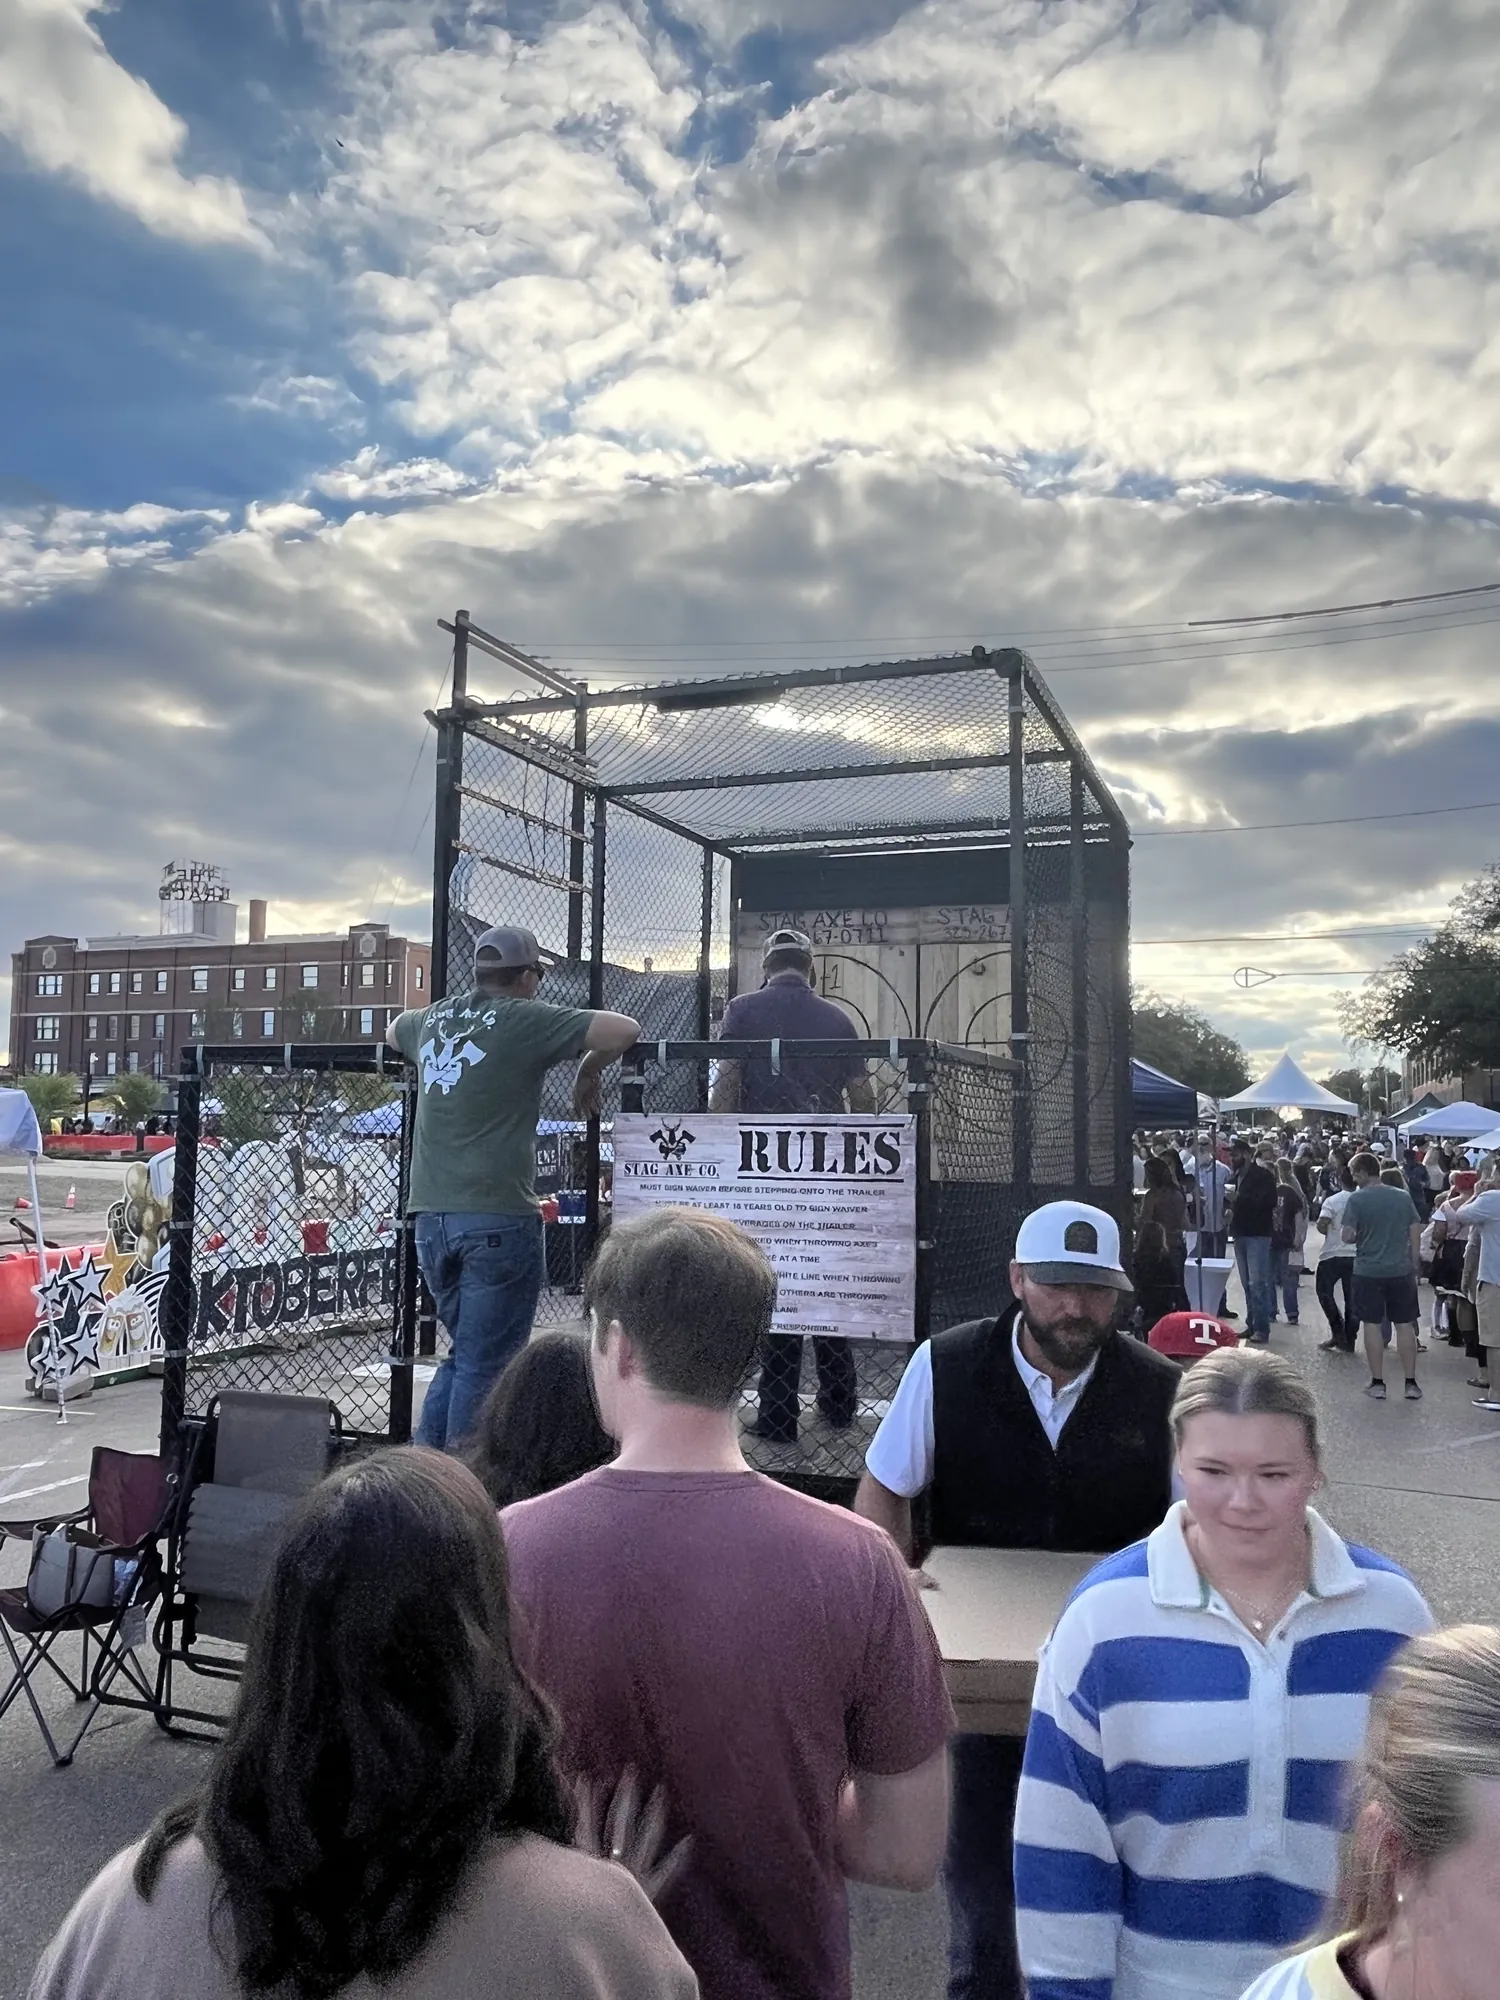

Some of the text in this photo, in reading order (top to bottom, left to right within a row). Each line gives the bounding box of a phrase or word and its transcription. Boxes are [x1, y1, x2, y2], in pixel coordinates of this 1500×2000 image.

[758, 911, 806, 931] STAG
[813, 909, 854, 928] AXE
[937, 906, 995, 925] STAG
[737, 1129, 902, 1176] RULES
[624, 1162, 720, 1178] STAG AXE CO.
[664, 1184, 683, 1192] SIGN
[718, 1186, 752, 1194] BEFORE
[754, 1187, 797, 1195] STEPPING
[827, 1188, 844, 1196] THE
[847, 1188, 885, 1197] TRAILER
[744, 1203, 772, 1211] YEARS
[774, 1204, 793, 1212] OLD
[795, 1204, 807, 1212] TO
[832, 1205, 868, 1214] WAIVER
[782, 1220, 796, 1228] ON
[798, 1221, 815, 1229] THE
[817, 1221, 856, 1230] TRAILER
[774, 1238, 801, 1246] WHEN
[803, 1239, 851, 1247] THROWING
[800, 1256, 820, 1264] TIME
[800, 1273, 820, 1281] LINE
[823, 1274, 850, 1283] WHEN
[852, 1275, 901, 1284] THROWING
[779, 1289, 816, 1298] OTHERS
[838, 1291, 888, 1301] THROWING
[776, 1323, 839, 1333] RESPONSIBLE
[1189, 1318, 1222, 1346] T
